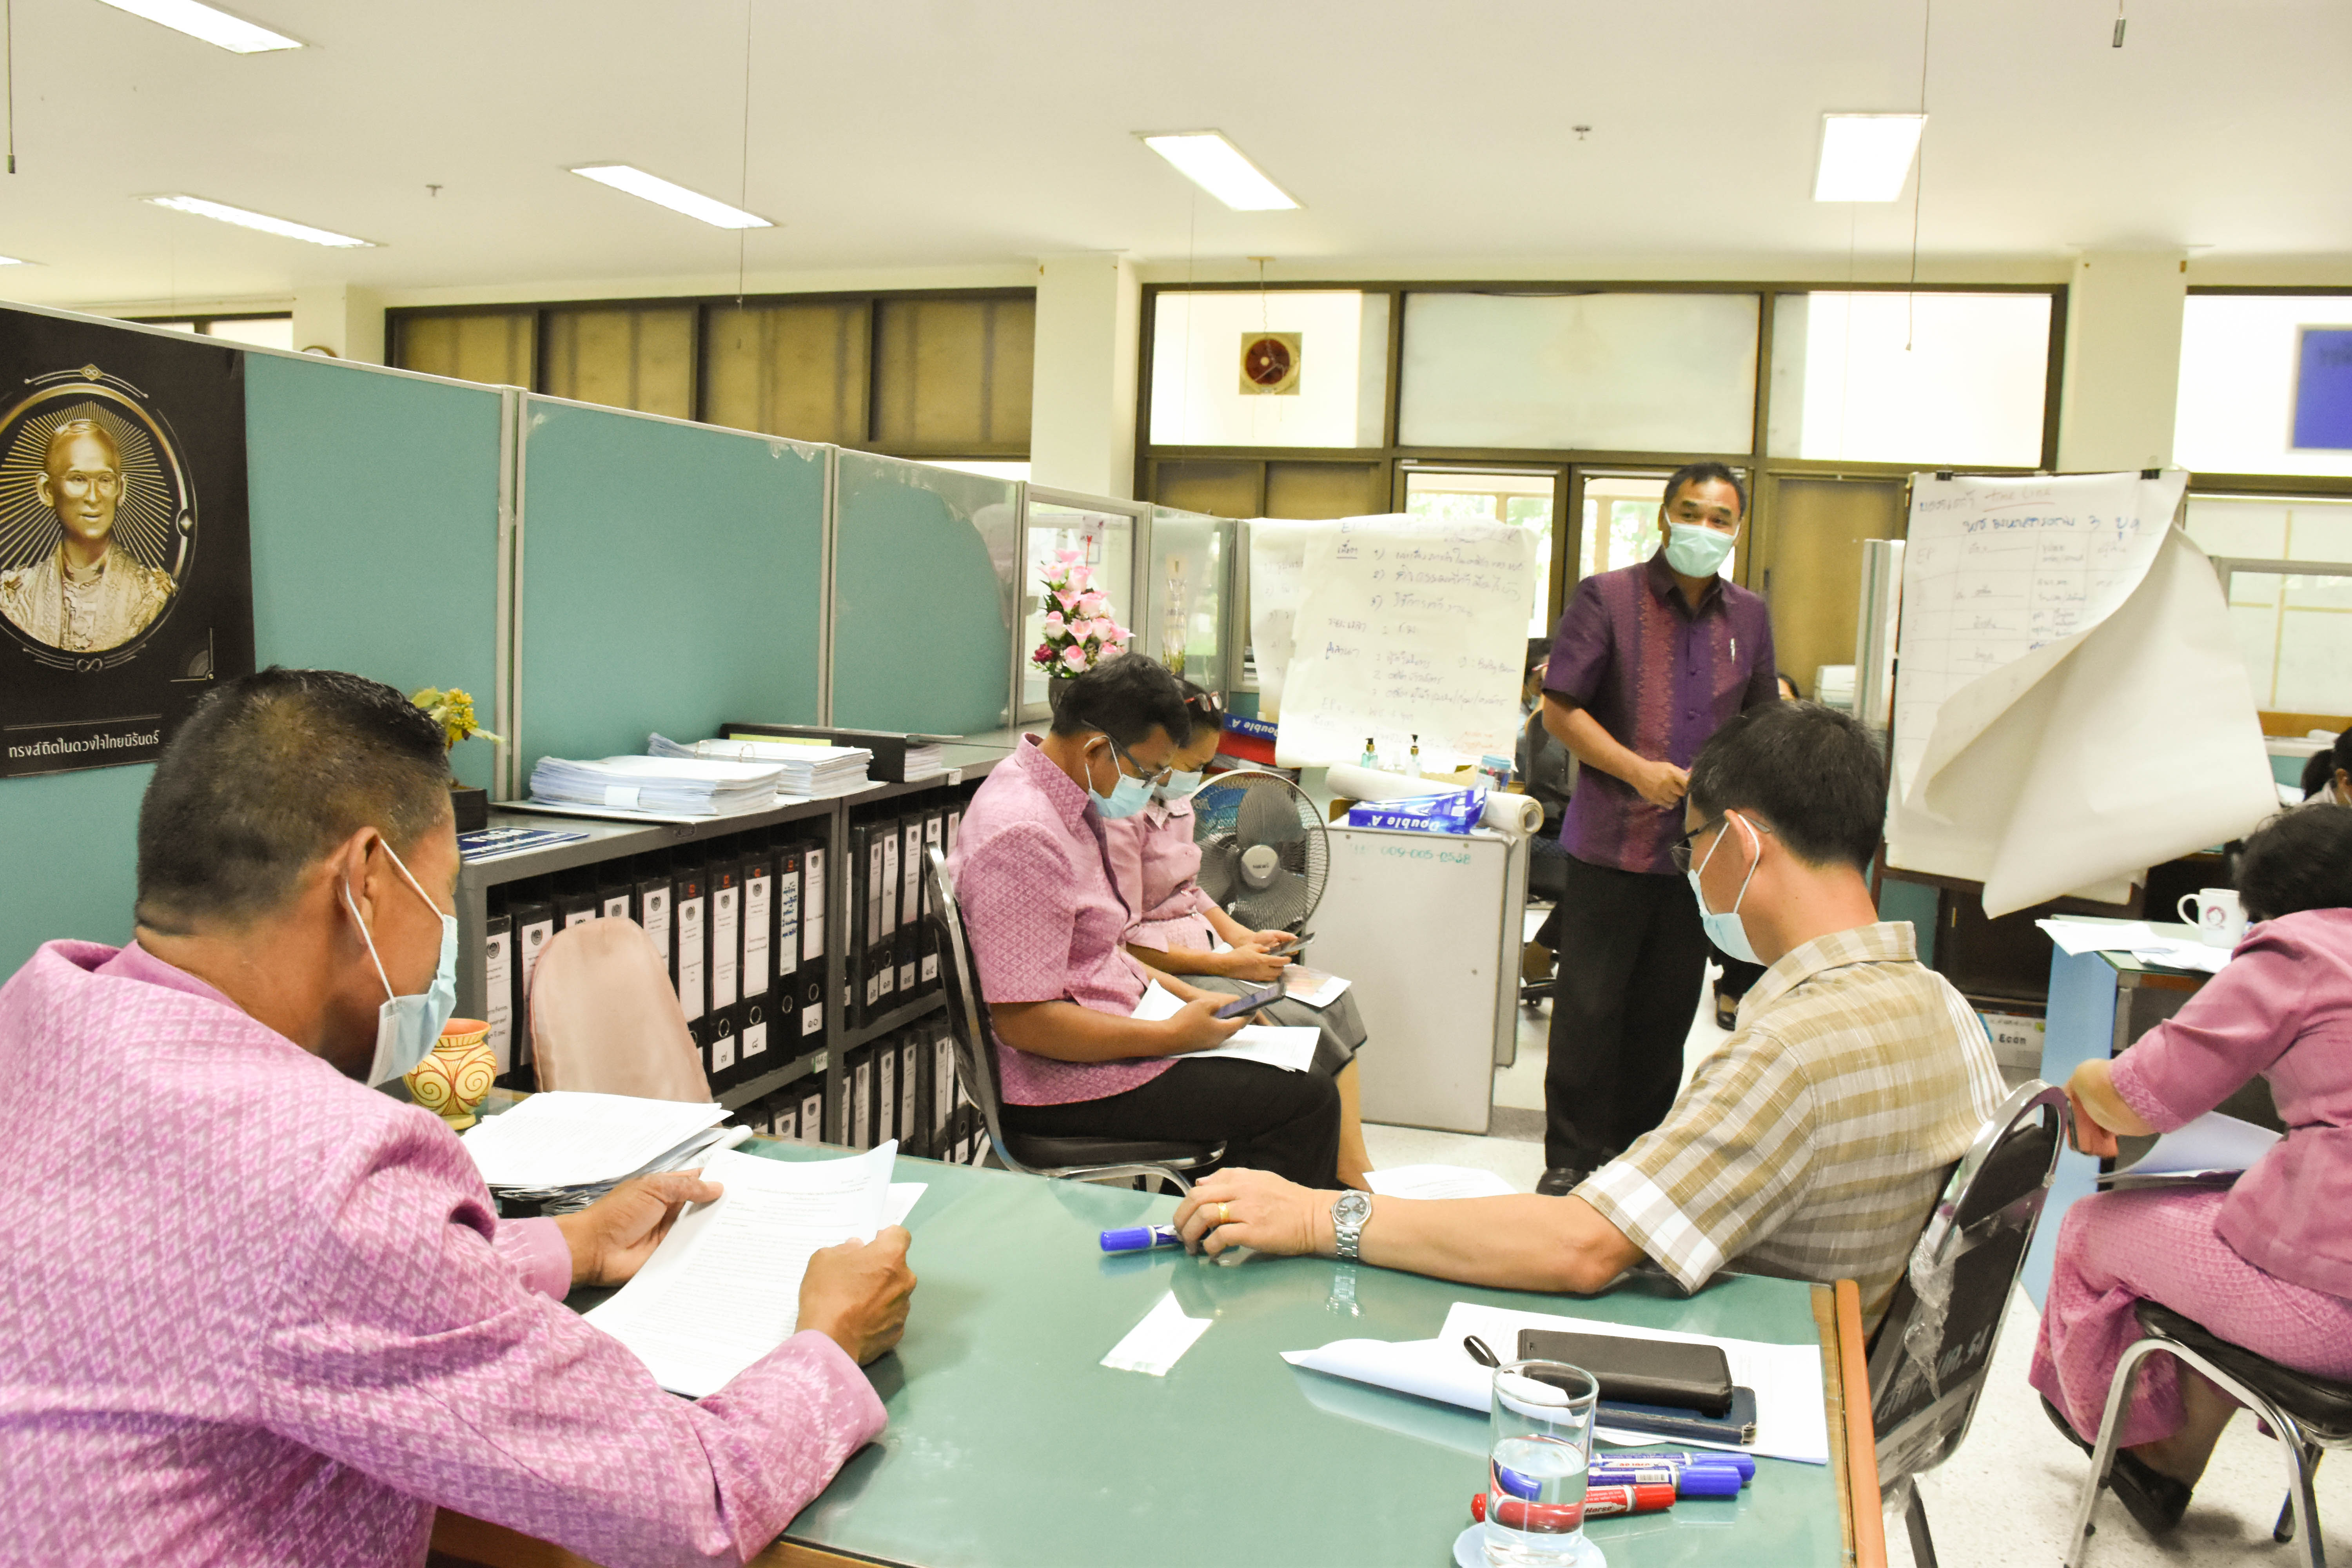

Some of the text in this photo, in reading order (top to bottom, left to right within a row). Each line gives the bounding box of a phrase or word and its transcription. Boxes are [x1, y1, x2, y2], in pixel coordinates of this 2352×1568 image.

[1232, 719, 1241, 728] A
[9, 730, 160, 758] ทรงสถิตในดวงใจไทยนิรันดร์
[1372, 815, 1441, 832] Double A
